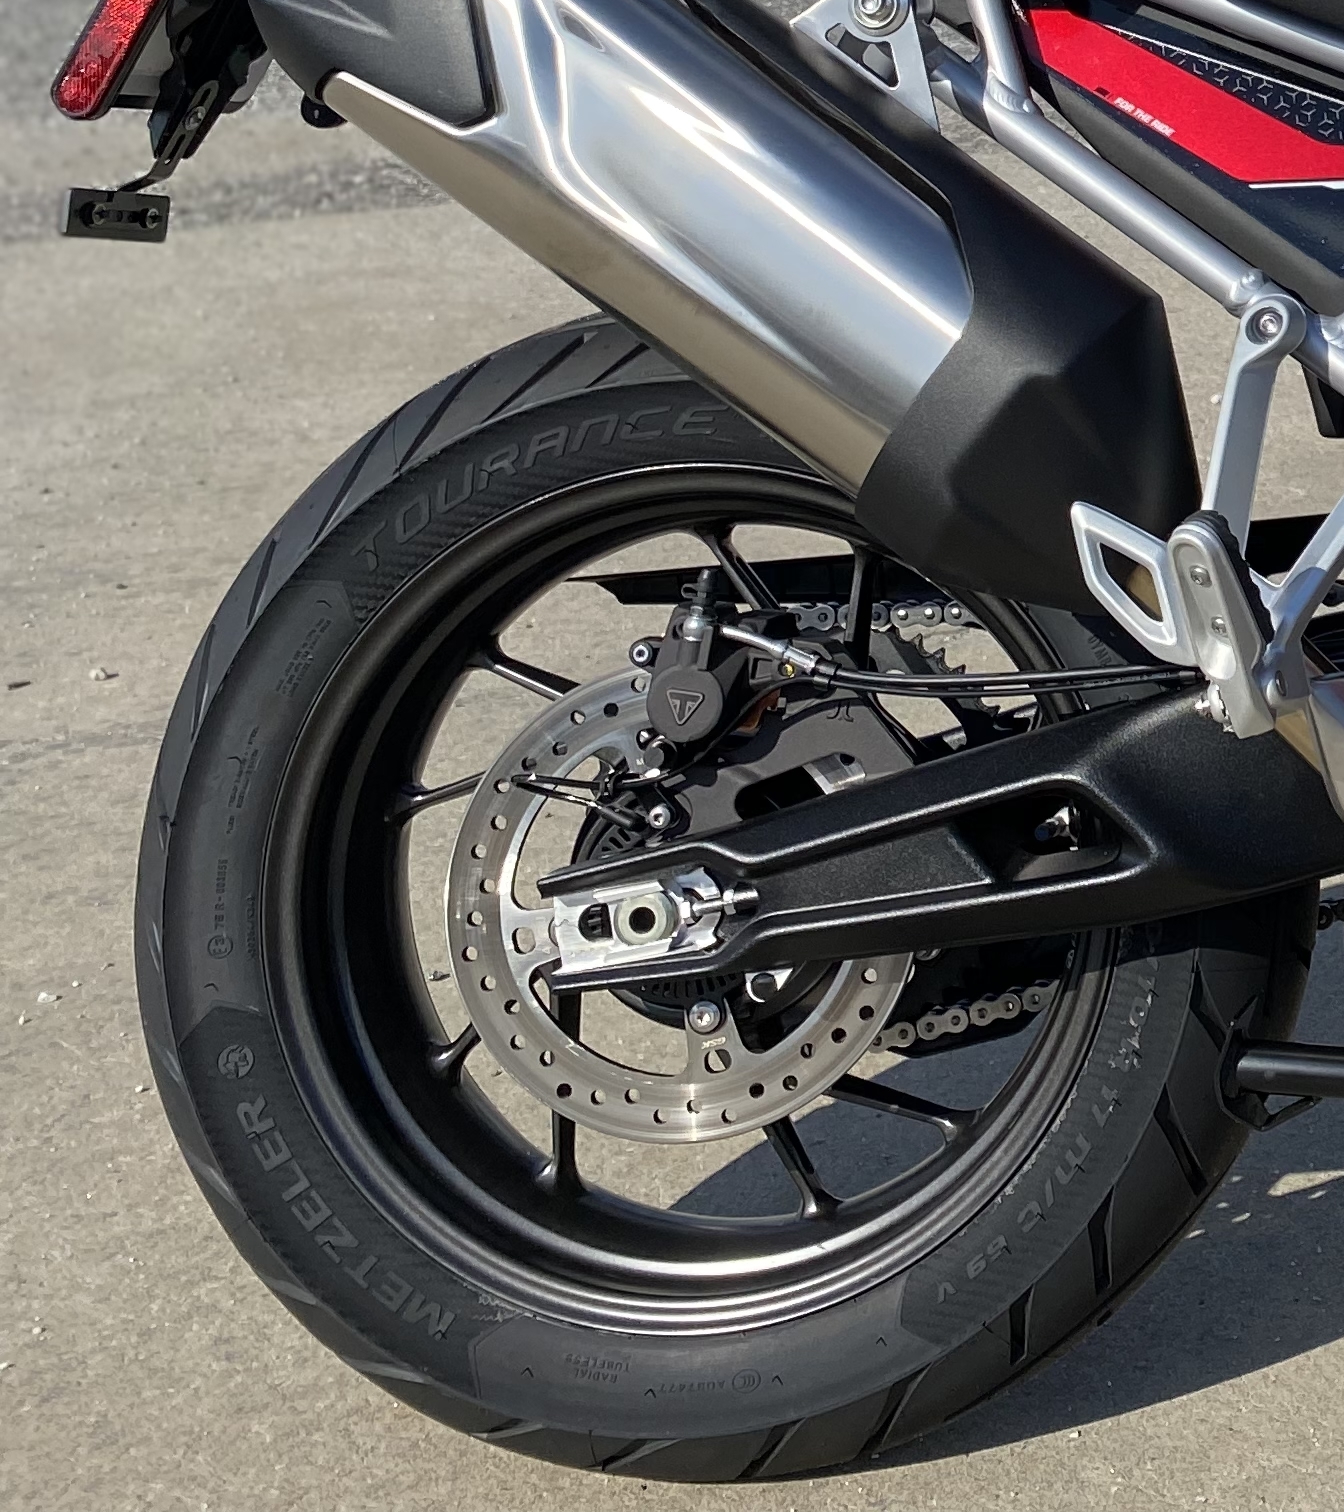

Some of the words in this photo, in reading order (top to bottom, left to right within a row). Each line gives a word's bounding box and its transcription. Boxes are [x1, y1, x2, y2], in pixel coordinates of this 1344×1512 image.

[1132, 107, 1155, 124] THE
[1150, 118, 1177, 138] RIDE
[350, 399, 732, 572] TOURANCE
[234, 1094, 456, 1342] METZELER
[572, 1366, 619, 1385] RADIAL
